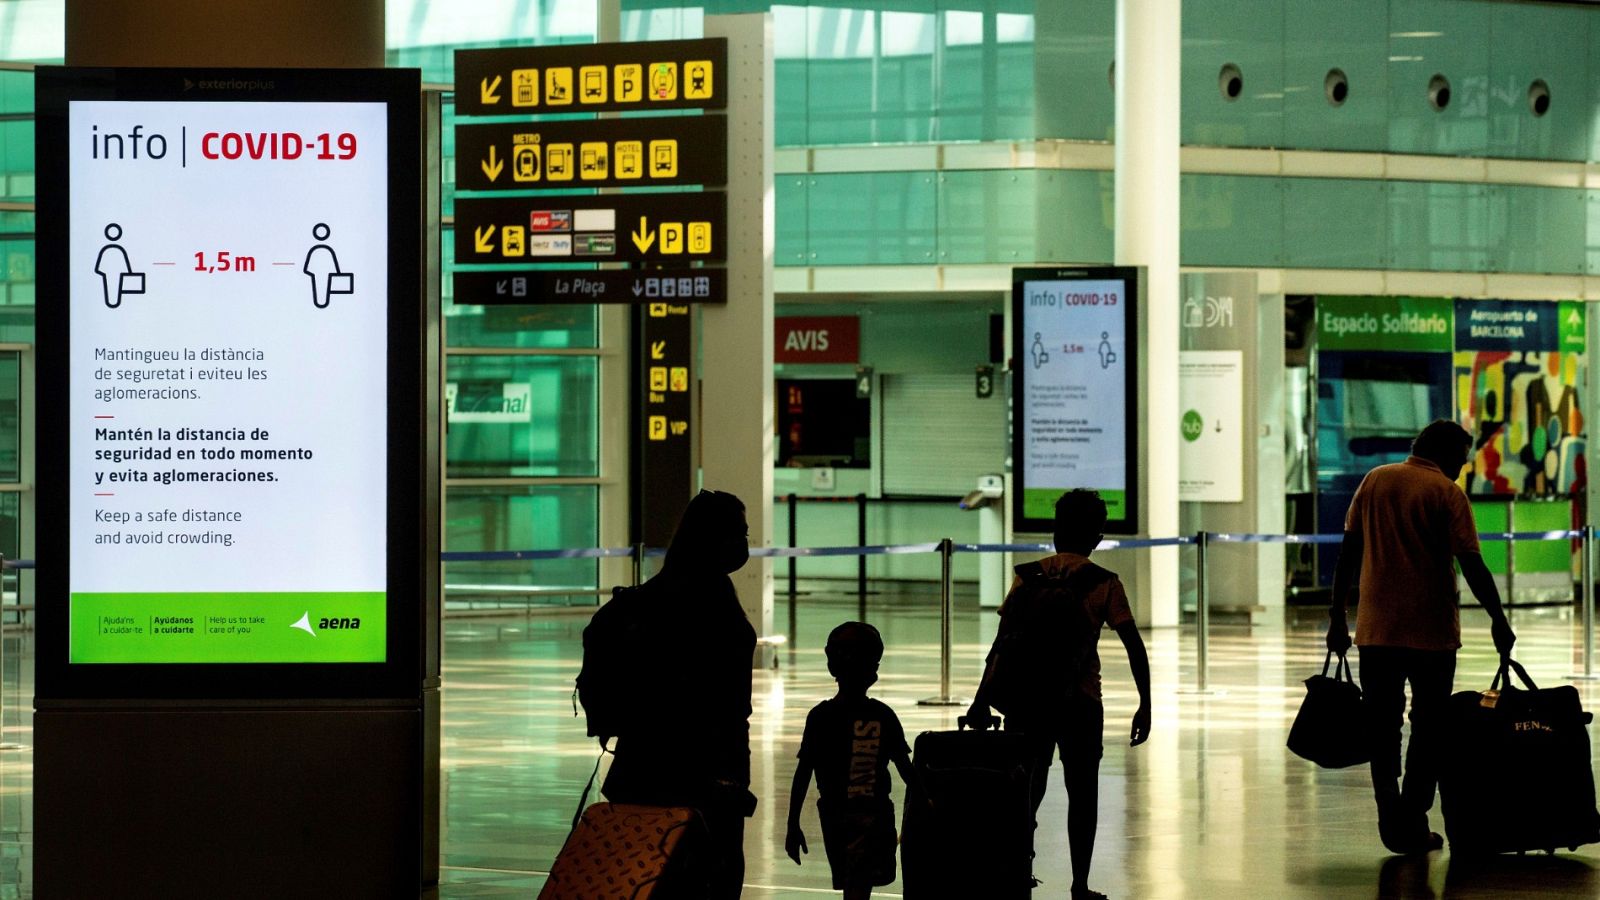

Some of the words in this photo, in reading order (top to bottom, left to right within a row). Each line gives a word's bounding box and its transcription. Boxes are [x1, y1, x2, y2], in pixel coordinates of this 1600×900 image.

[622, 68, 635, 78] VIP
[91, 124, 168, 161] info
[201, 131, 358, 161] COVID-19
[513, 133, 540, 144] METRO
[616, 144, 640, 152] HOTEL
[533, 216, 549, 226] AVIS
[555, 279, 569, 294] La
[572, 278, 606, 297] Plaça
[1030, 290, 1056, 306] info
[1066, 293, 1118, 306] COVID-19
[1323, 312, 1378, 336] Espacio
[1382, 312, 1447, 334] Solidario
[1470, 309, 1524, 324] Aeropuerto
[1525, 311, 1538, 322] de
[1470, 325, 1525, 338] BARCELONA
[784, 330, 829, 351] AVIS
[95, 347, 179, 364] Mantingueu
[184, 347, 196, 361] la
[200, 347, 265, 361] distància
[94, 367, 112, 380] de
[116, 367, 185, 383] seguretat
[198, 367, 243, 380] eviteu
[247, 367, 268, 380] les
[858, 377, 868, 392] 4
[980, 376, 990, 393] 3
[94, 386, 201, 402] aglomeracions.
[94, 427, 153, 441] Mantén
[158, 427, 171, 441] la
[176, 427, 246, 441] distancia
[250, 427, 270, 441] de
[670, 421, 688, 435] VIP
[94, 447, 172, 463] seguridad
[176, 450, 196, 460] en
[200, 447, 236, 460] todo
[240, 448, 313, 460] momento
[94, 471, 104, 485] y
[109, 470, 148, 482] evita
[152, 469, 279, 485] aglomeraciones.
[94, 509, 130, 525] Keep
[134, 512, 143, 522] a
[147, 508, 178, 522] safe
[182, 509, 242, 522] distance
[94, 531, 121, 544] and
[125, 531, 164, 544] avoid
[167, 531, 236, 547] crowding.
[103, 616, 135, 626] Ajuda'ns
[154, 616, 194, 626] Ayúdanos
[209, 616, 227, 626] Help
[239, 616, 248, 624] to
[248, 616, 266, 624] take
[318, 616, 361, 630] aena
[110, 626, 143, 634] cuidar-te
[161, 626, 194, 634] cuidarte
[226, 626, 235, 634] of
[236, 627, 251, 636] you
